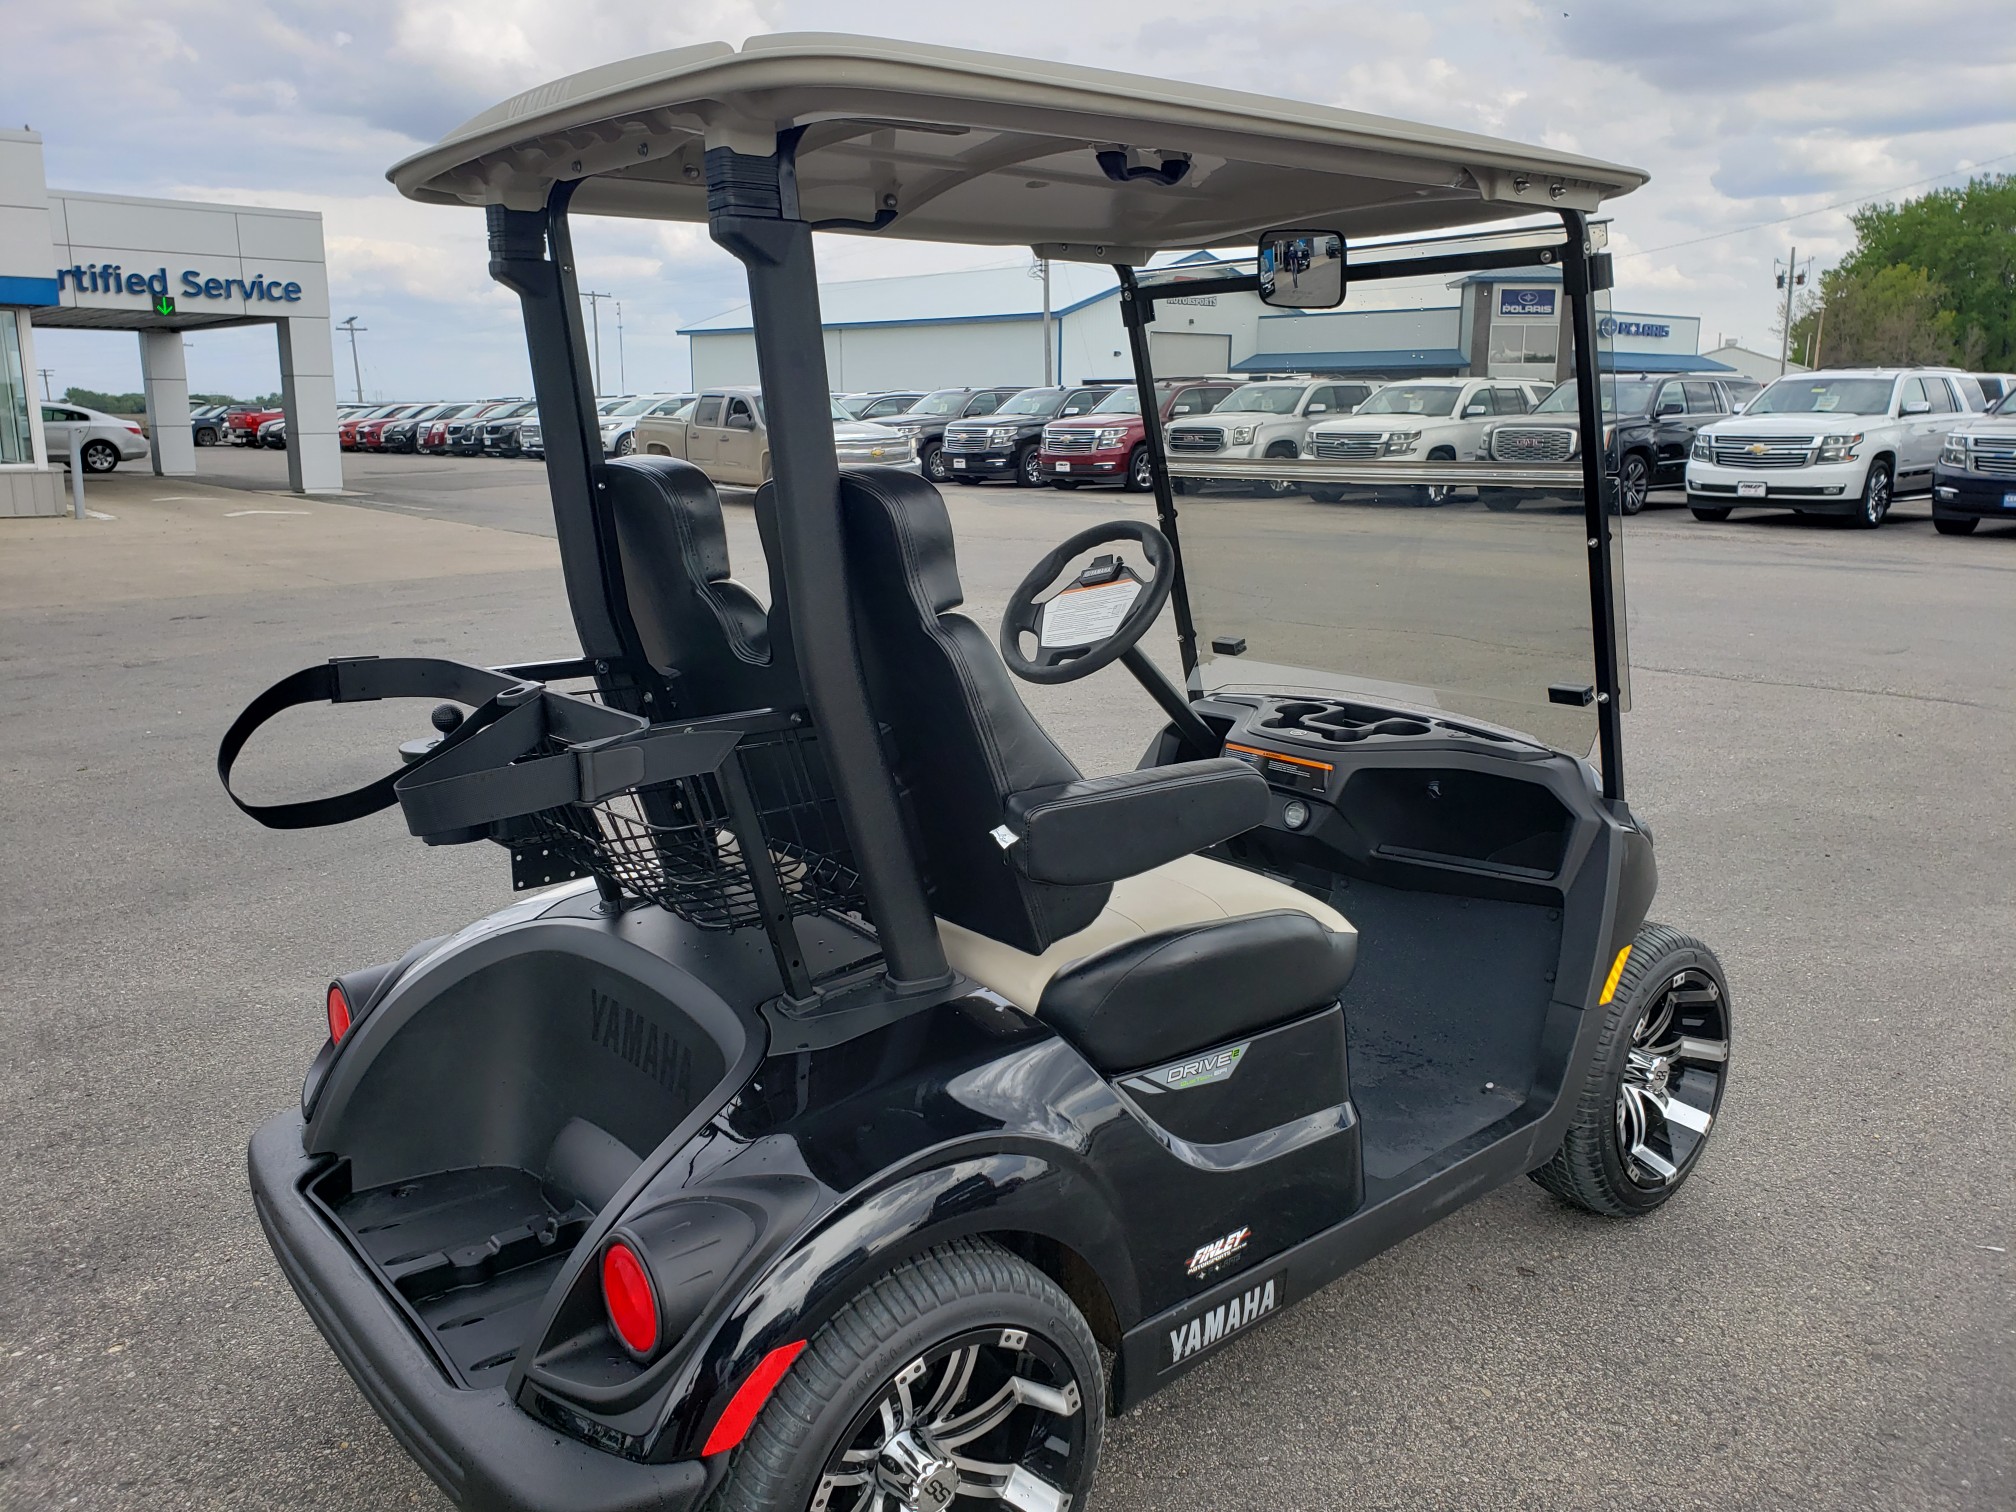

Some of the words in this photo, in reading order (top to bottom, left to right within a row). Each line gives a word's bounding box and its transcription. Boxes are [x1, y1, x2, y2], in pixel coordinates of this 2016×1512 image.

[58, 263, 168, 296] rtified
[181, 270, 302, 302] Service
[1502, 304, 1552, 313] POLARIS
[1618, 322, 1670, 337] POLARIS
[1089, 567, 1112, 576] YAMAHA
[591, 988, 692, 1106] YAMAHA
[1187, 1250, 1232, 1275] MOTORSPORTS
[1189, 1226, 1249, 1269] FINLEY
[1169, 1278, 1275, 1363] YAMAHA
